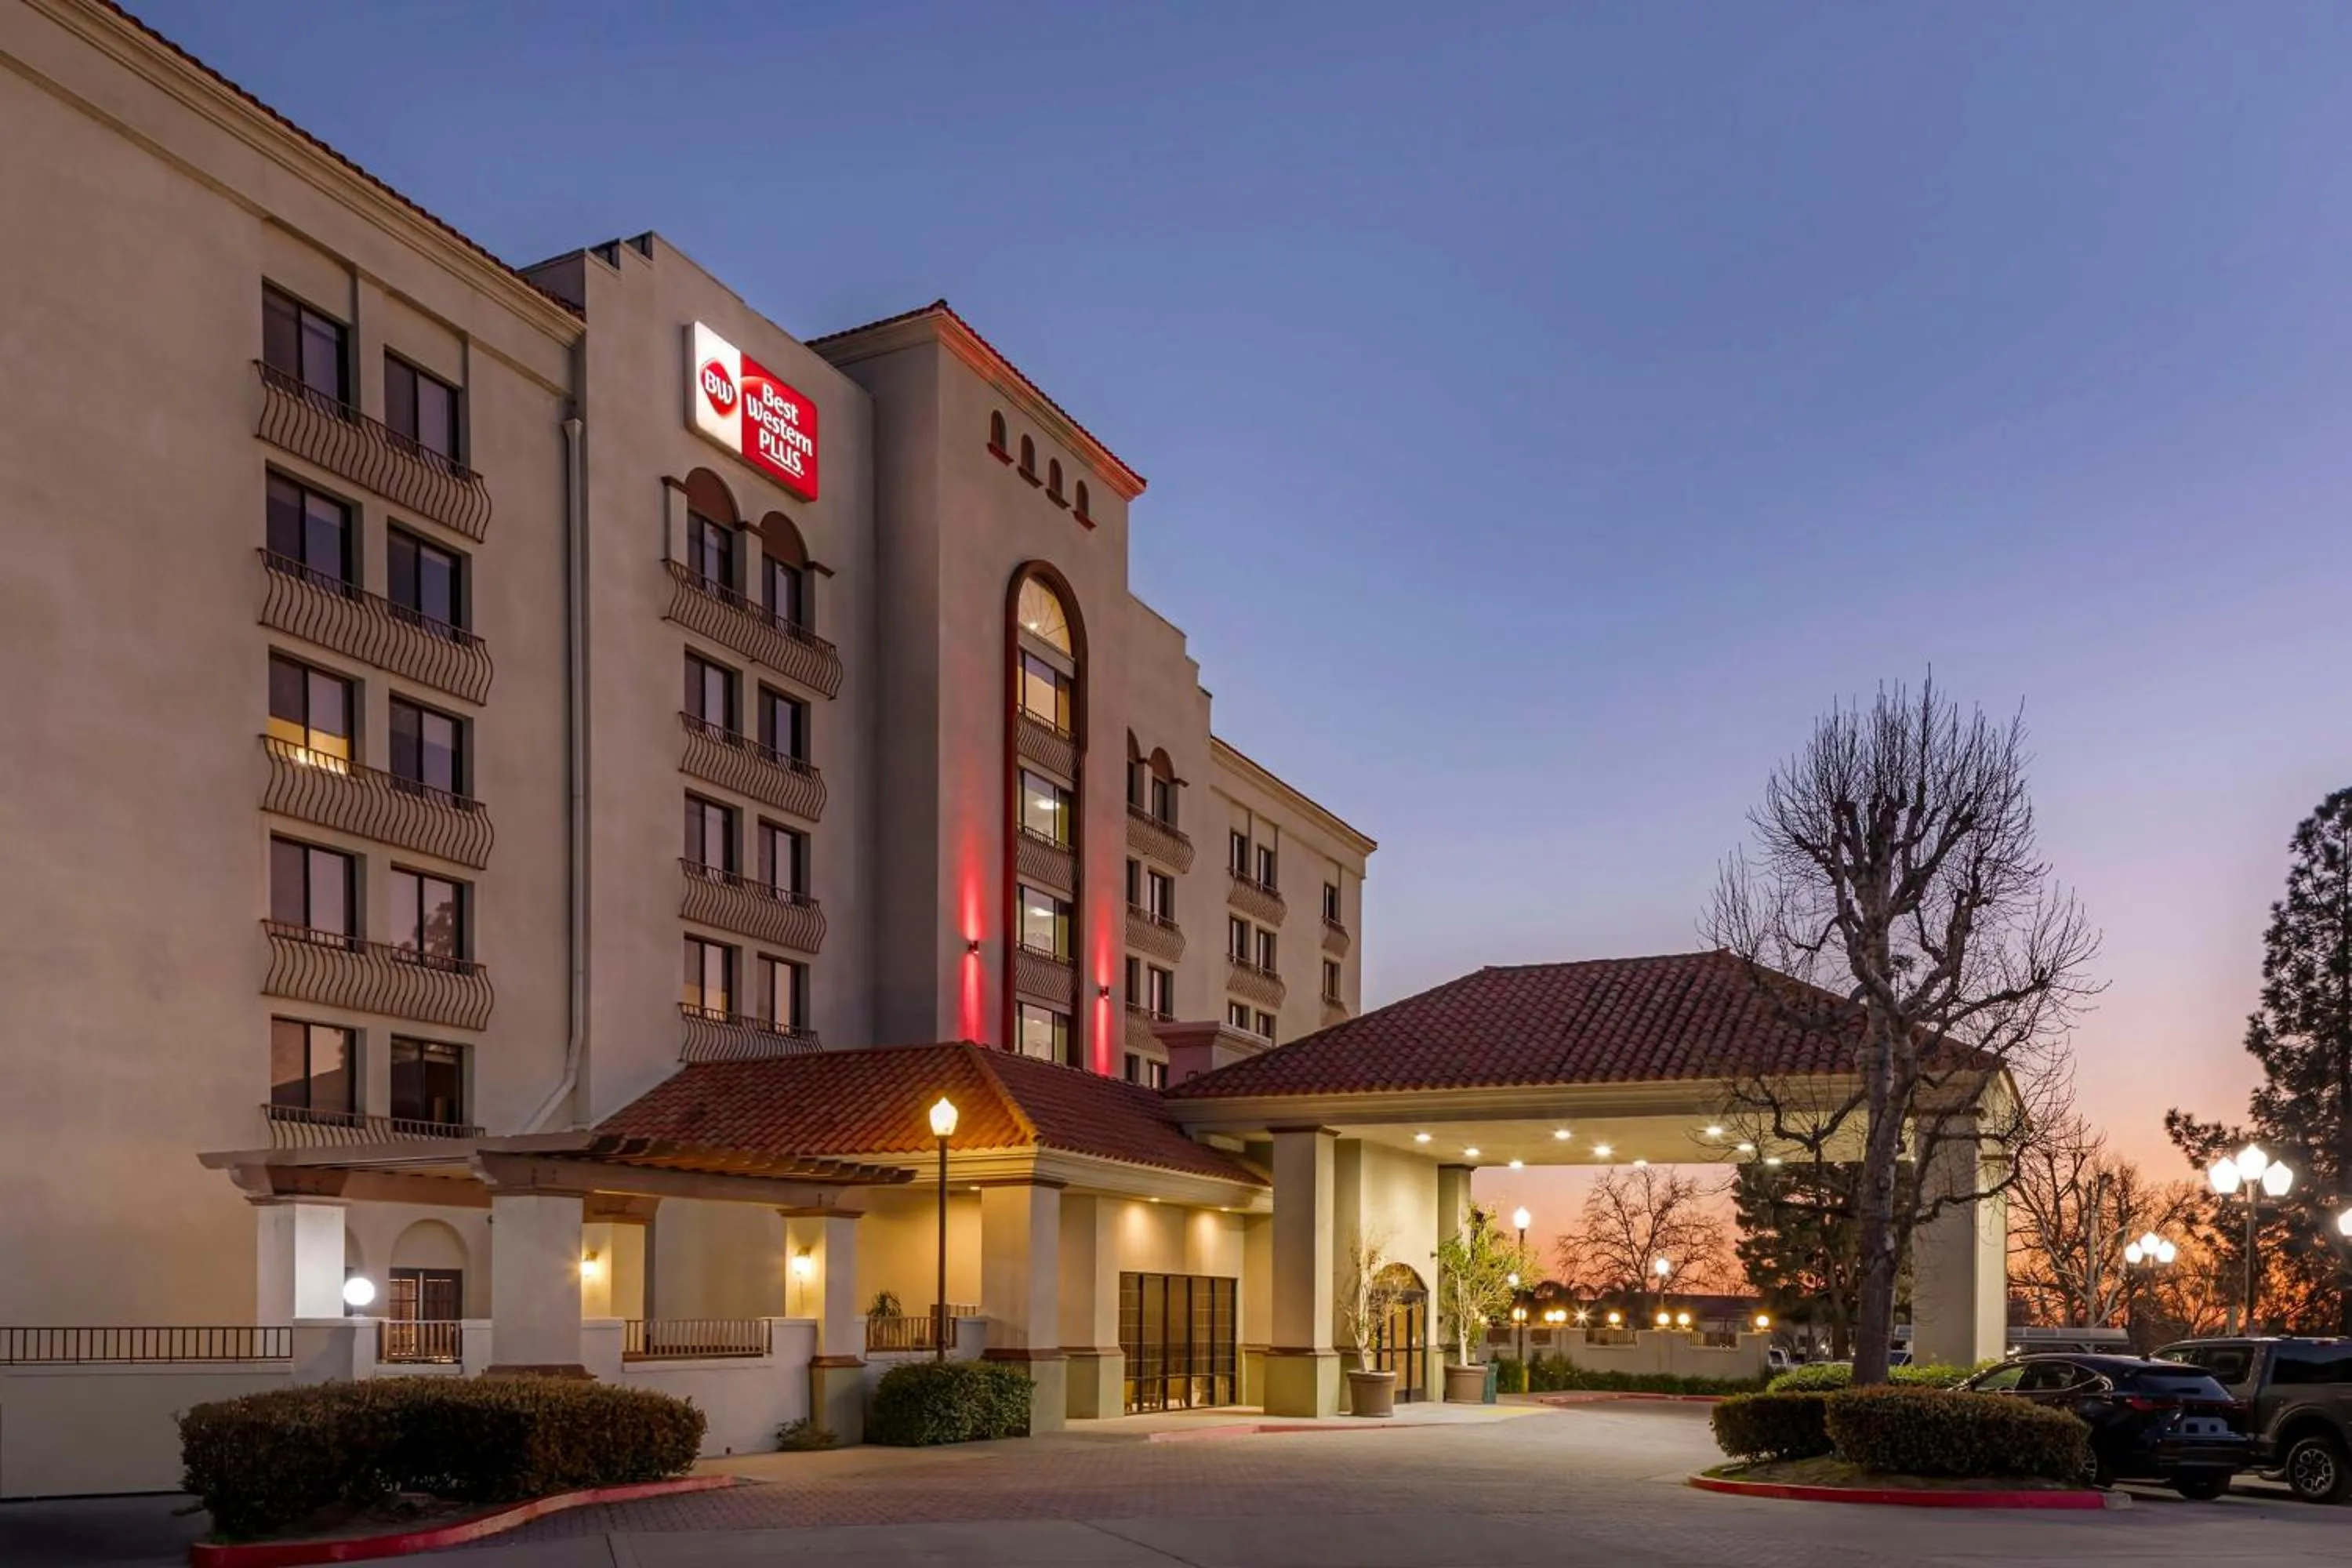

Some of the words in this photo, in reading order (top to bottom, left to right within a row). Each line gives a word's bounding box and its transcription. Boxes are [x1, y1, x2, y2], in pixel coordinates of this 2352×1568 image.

[705, 369, 733, 404] BW
[762, 383, 799, 425] Best
[746, 394, 813, 456] Western
